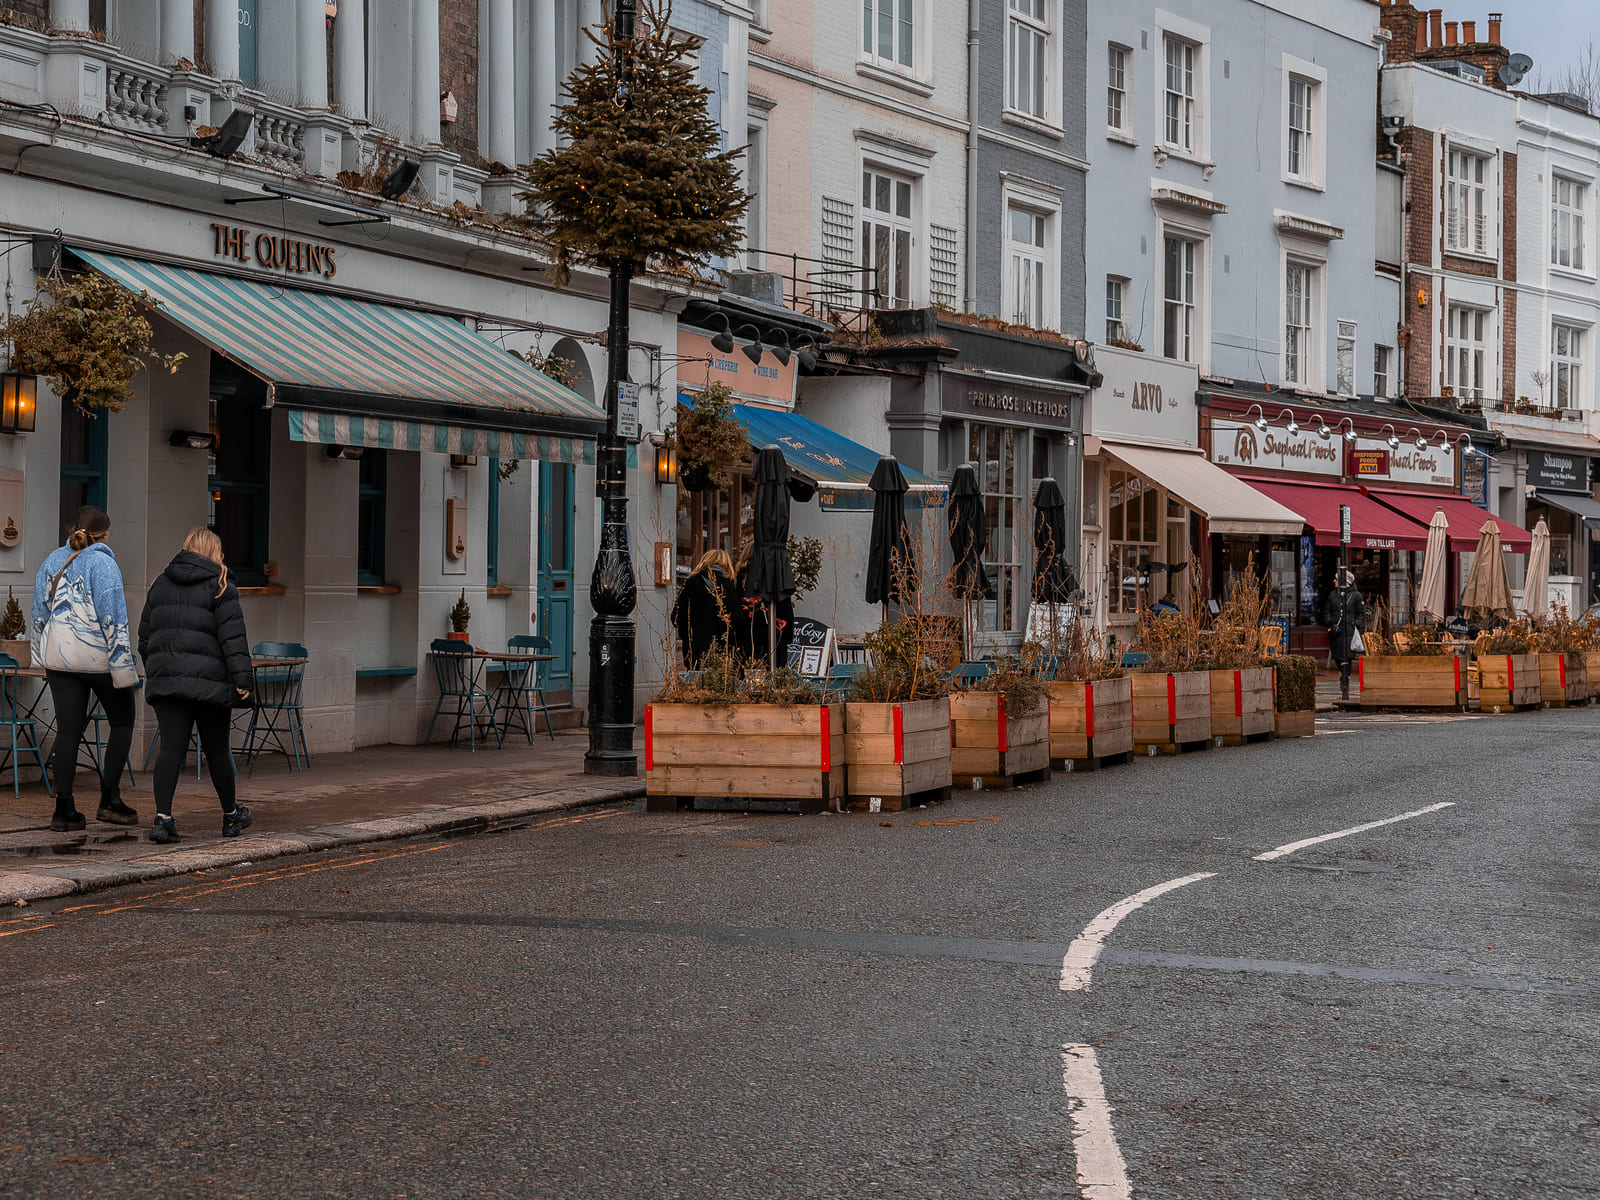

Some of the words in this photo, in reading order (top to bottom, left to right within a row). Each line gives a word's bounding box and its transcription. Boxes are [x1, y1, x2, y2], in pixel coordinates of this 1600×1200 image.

[210, 223, 251, 260] THE
[256, 233, 336, 277] QUEEN'S
[973, 391, 1019, 412] PRIMROSE
[1022, 399, 1069, 418] INTERIORS
[1131, 381, 1162, 413] ARVO
[1263, 434, 1307, 467] Shepherd
[1307, 439, 1337, 461] Foods
[1543, 452, 1573, 472] Shampoo
[1366, 538, 1377, 547] OPEN
[1377, 539, 1386, 548] TILL
[1385, 539, 1395, 548] LATE
